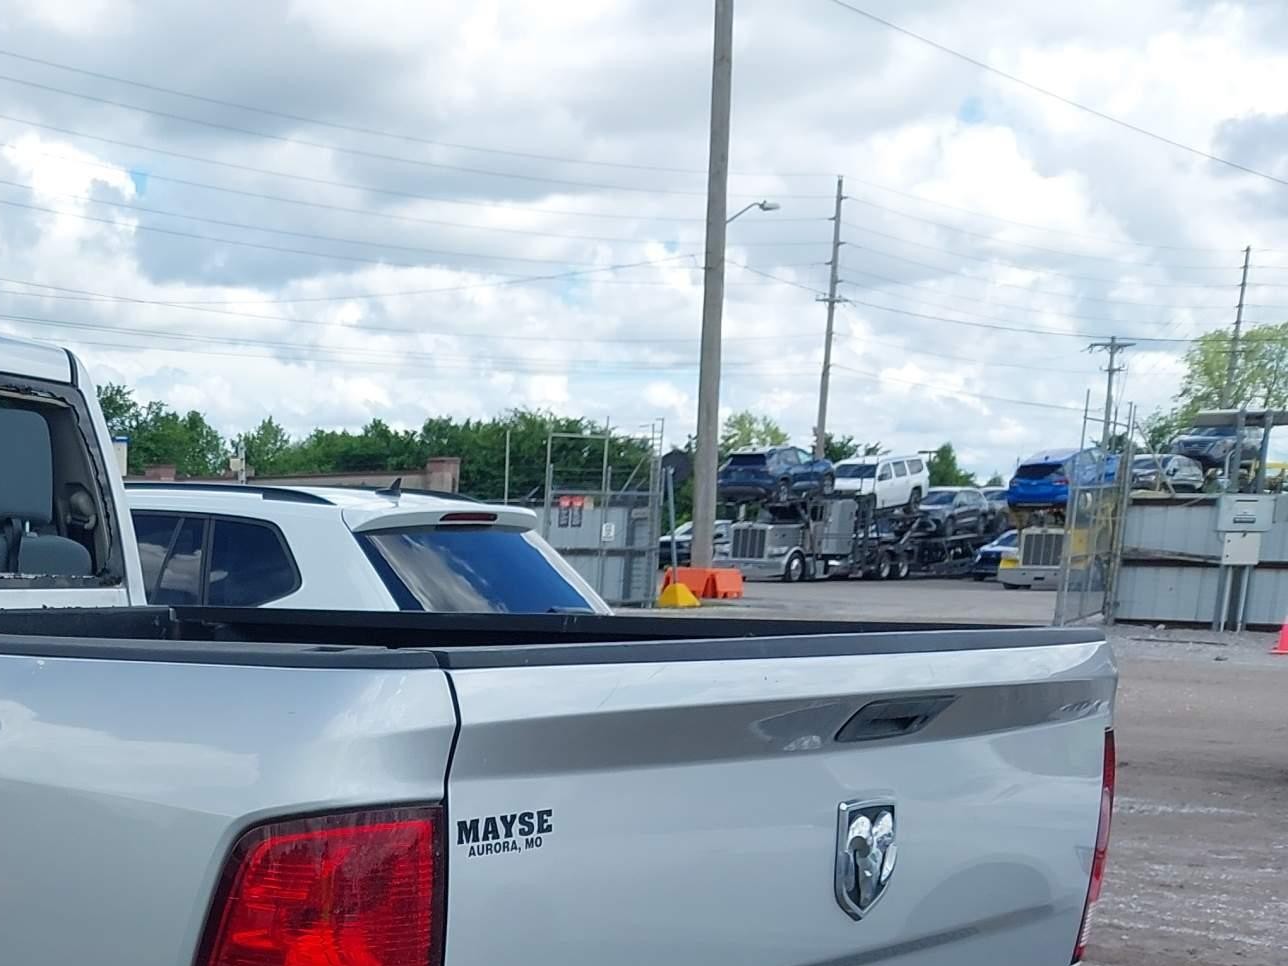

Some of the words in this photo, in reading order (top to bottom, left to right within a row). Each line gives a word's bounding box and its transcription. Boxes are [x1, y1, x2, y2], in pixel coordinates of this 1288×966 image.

[456, 809, 553, 845] MAYSE
[468, 840, 522, 857] AURORA,
[524, 836, 543, 850] MO
